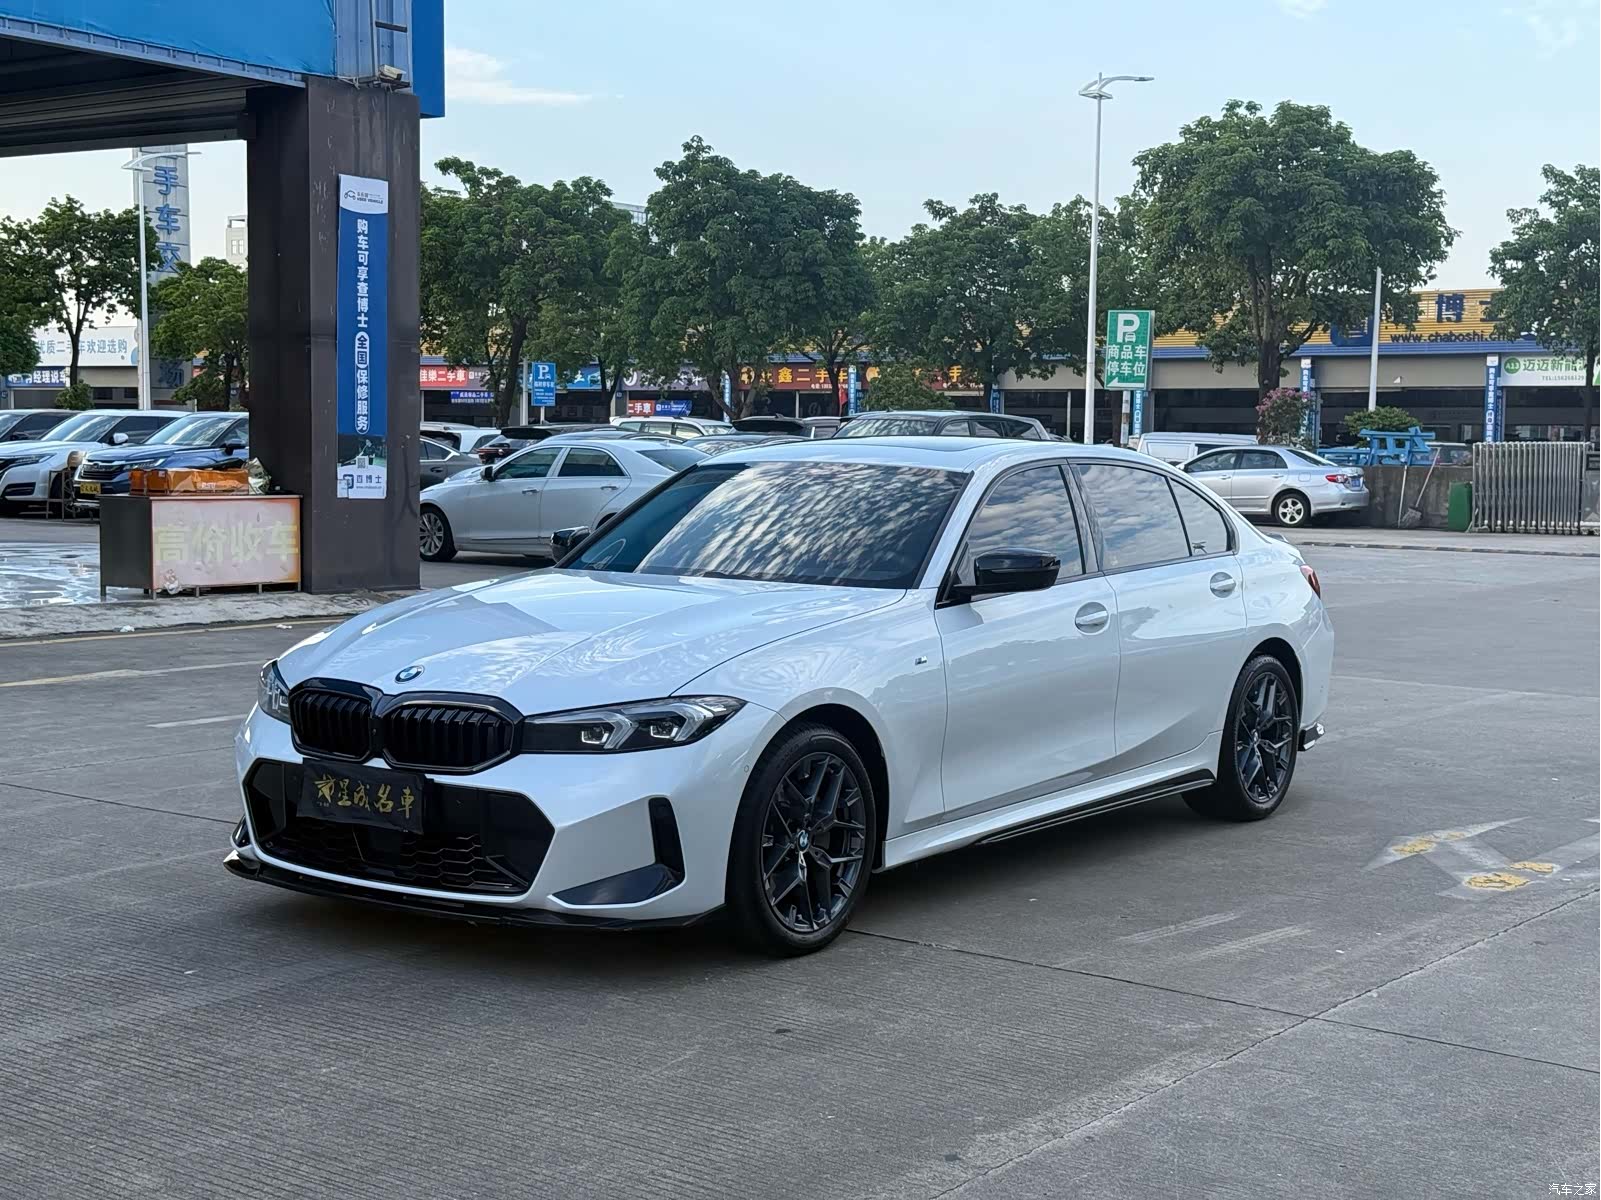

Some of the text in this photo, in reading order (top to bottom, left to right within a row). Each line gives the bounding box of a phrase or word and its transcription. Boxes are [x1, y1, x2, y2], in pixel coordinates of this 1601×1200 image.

[355, 218, 369, 433] 购车可享查博士 全国保修服务
[1117, 313, 1140, 343] P
[1106, 344, 1147, 360] 商品车
[1106, 361, 1146, 376] 停车位
[1505, 362, 1520, 370] A13
